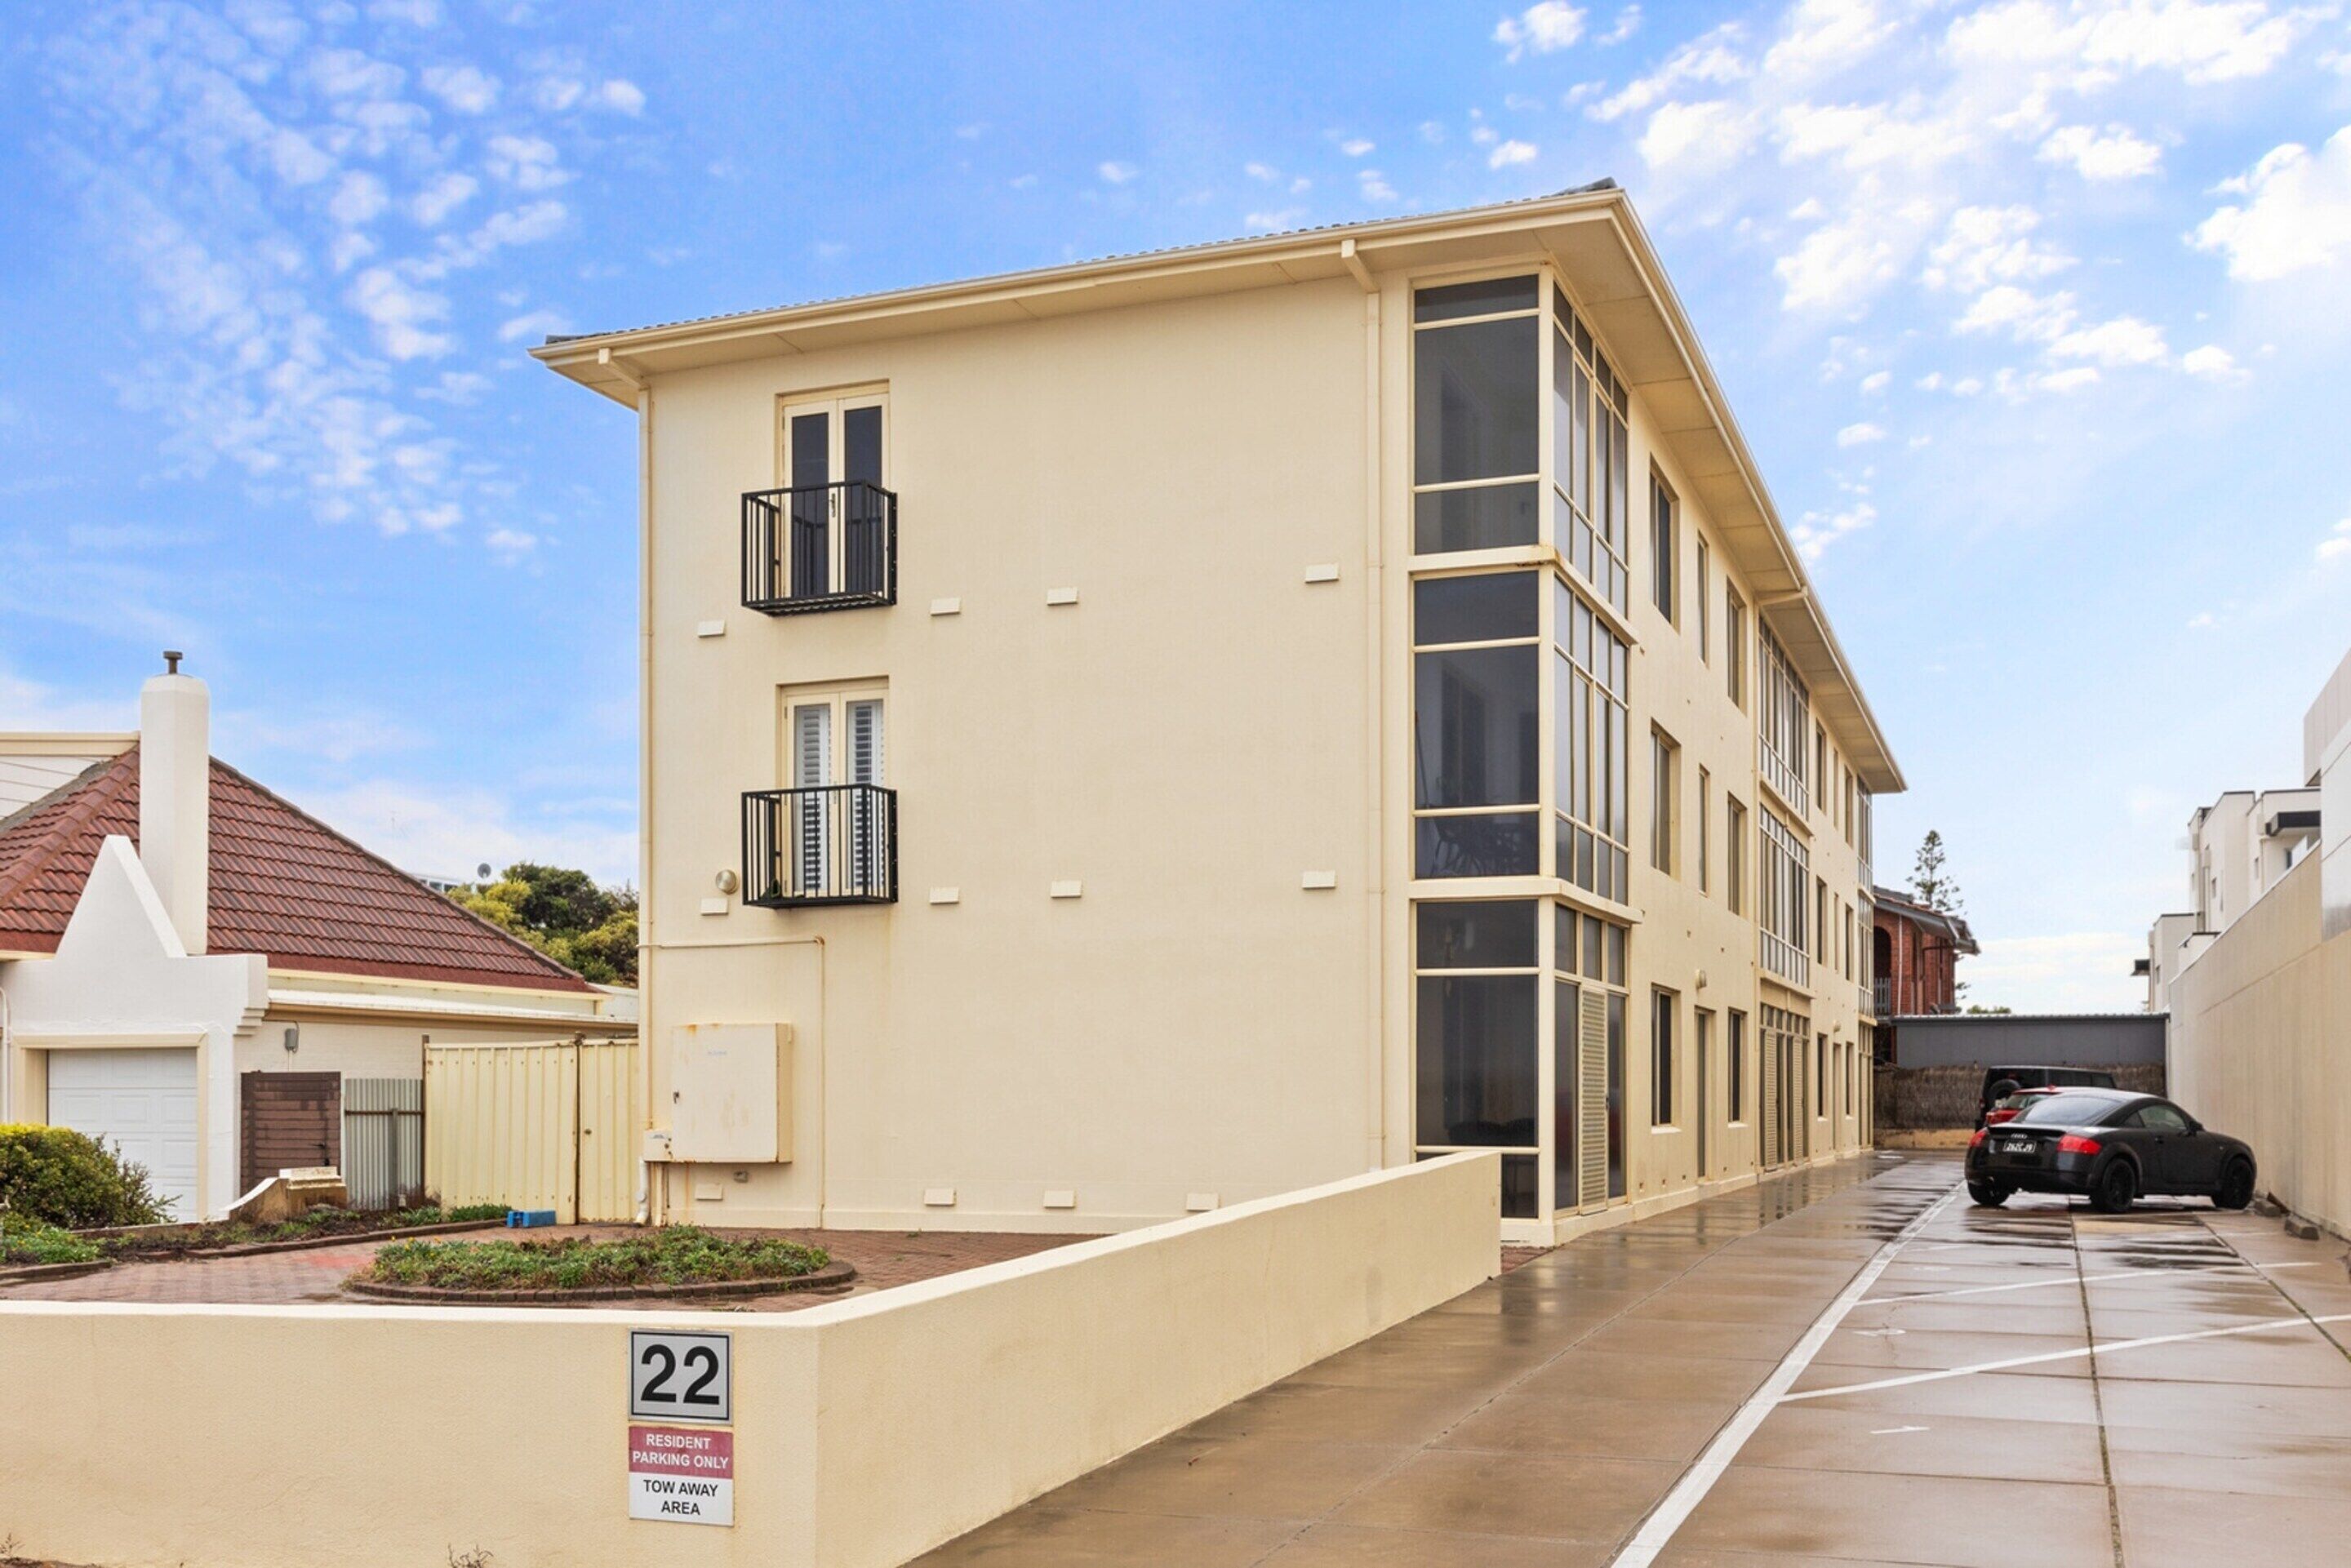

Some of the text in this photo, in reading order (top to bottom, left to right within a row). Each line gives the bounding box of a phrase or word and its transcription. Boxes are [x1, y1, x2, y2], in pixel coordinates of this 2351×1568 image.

[641, 1344, 720, 1405] 22
[646, 1433, 712, 1450] RESIDENT
[633, 1450, 729, 1469] PARKING ONLY
[643, 1479, 718, 1497] TOW AWAY
[660, 1500, 700, 1516] AREA
